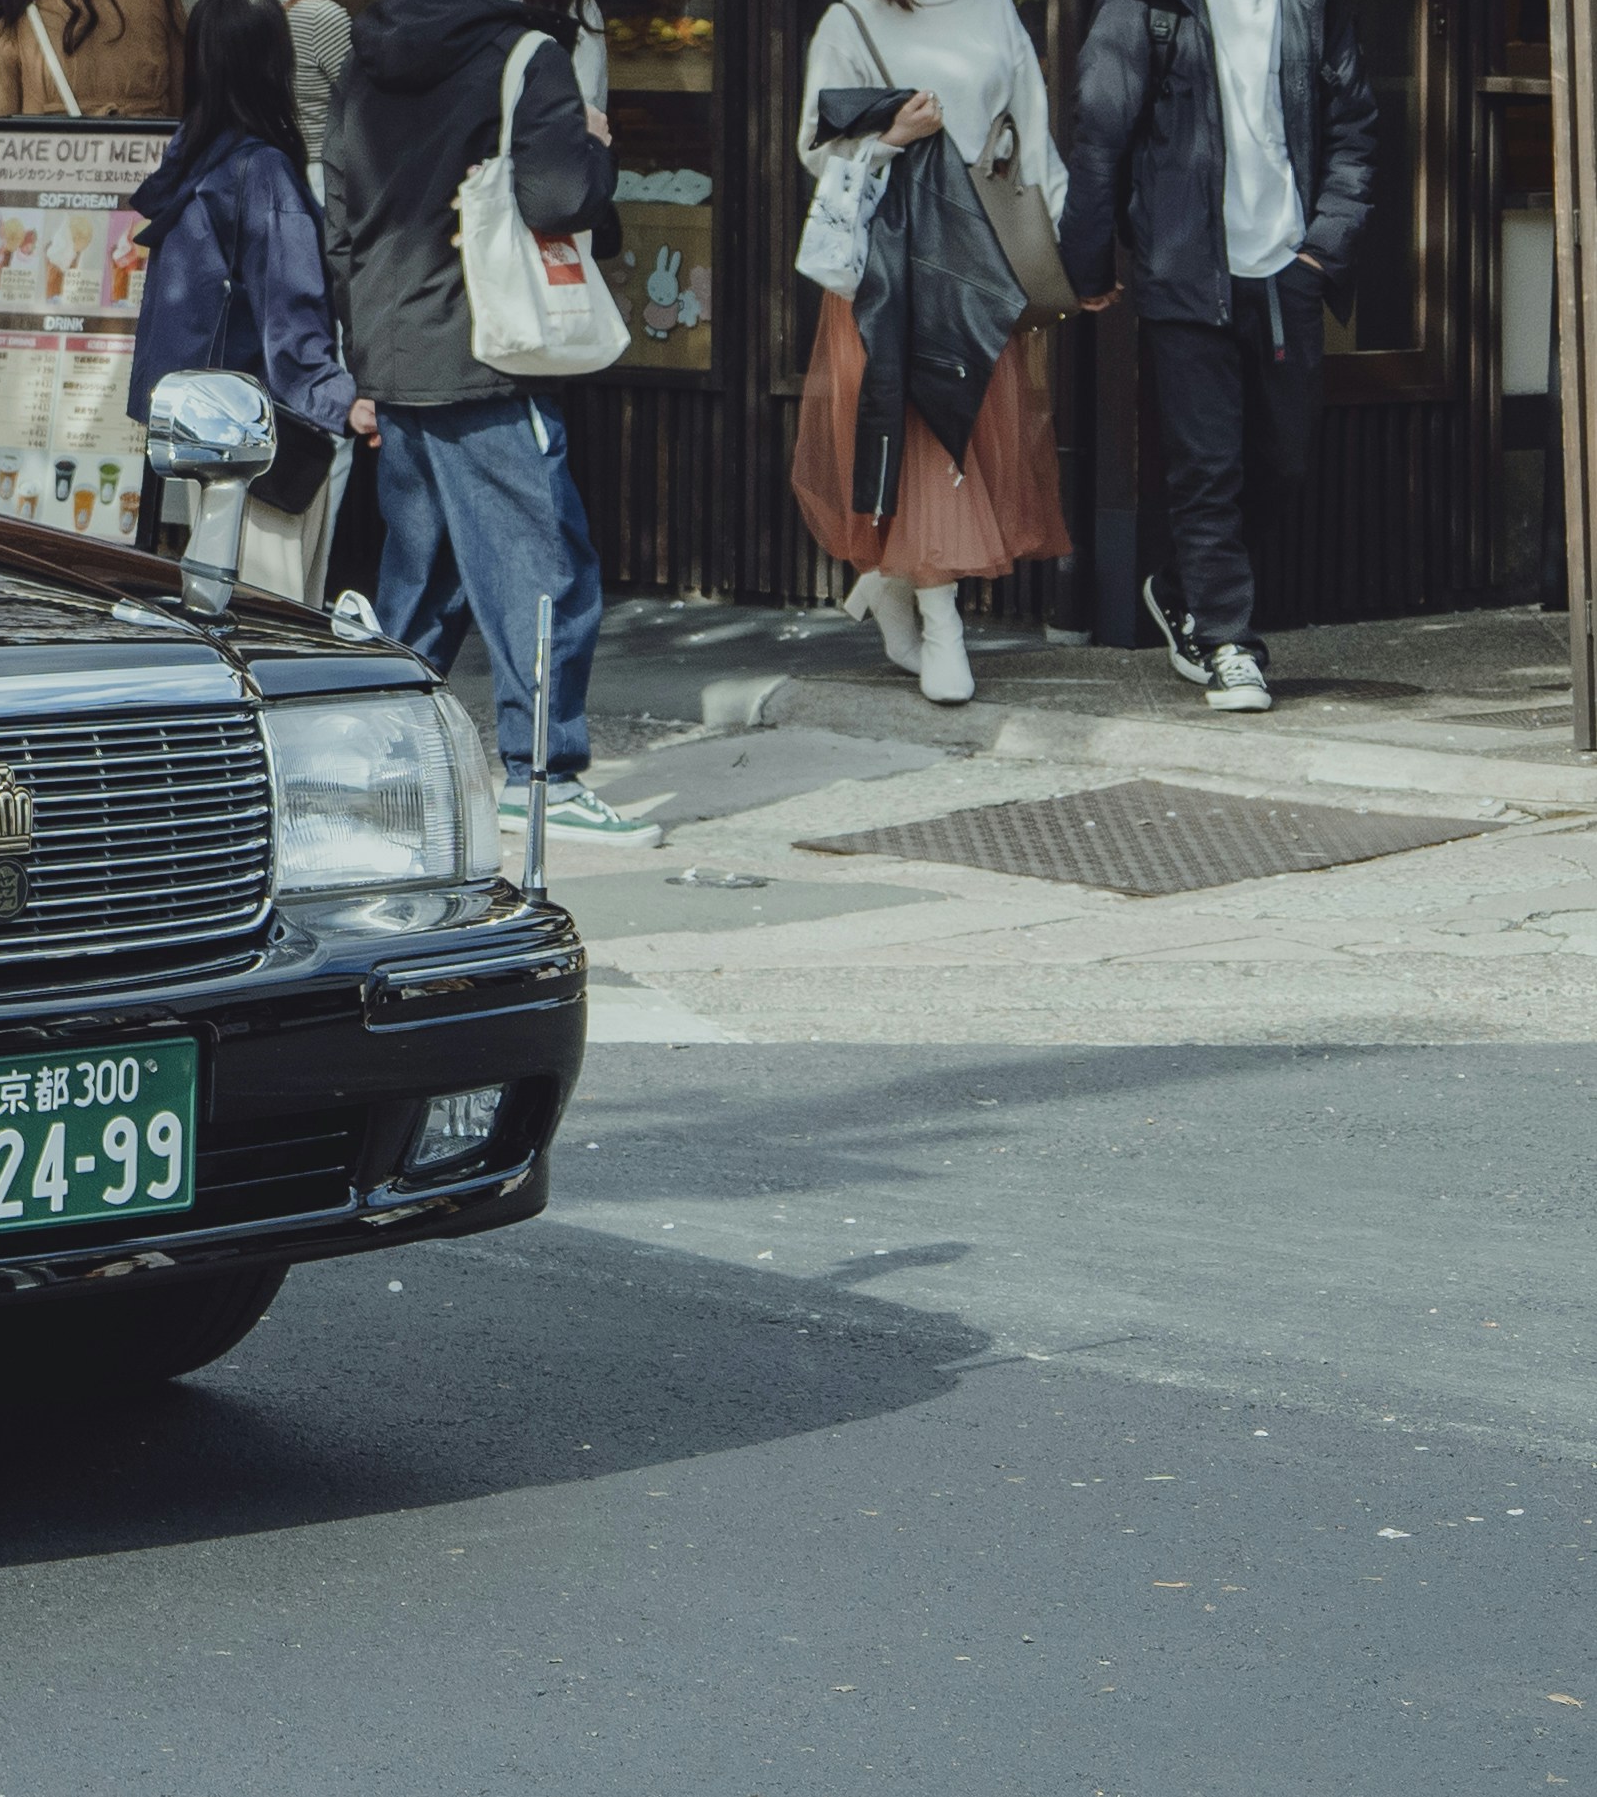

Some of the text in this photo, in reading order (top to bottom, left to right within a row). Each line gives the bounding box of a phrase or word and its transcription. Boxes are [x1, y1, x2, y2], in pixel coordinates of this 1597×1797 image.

[56, 140, 104, 162] OUT
[109, 140, 171, 163] MEN
[37, 193, 119, 208] SOFTCREAM
[43, 315, 84, 332] DRINK
